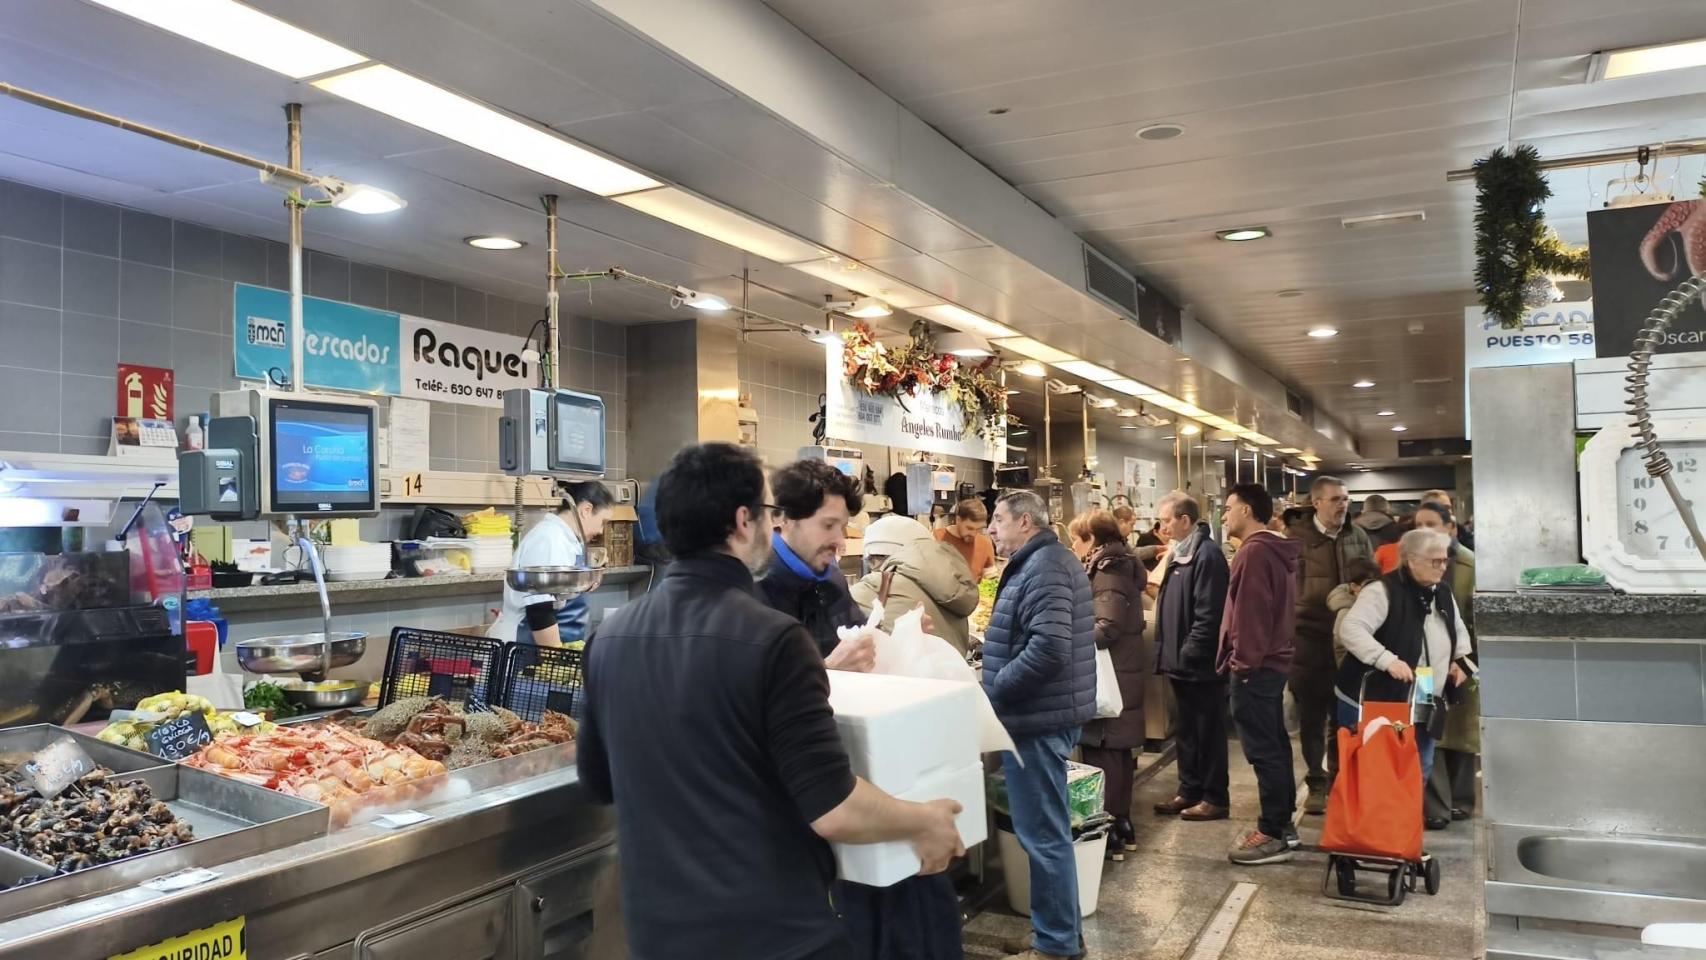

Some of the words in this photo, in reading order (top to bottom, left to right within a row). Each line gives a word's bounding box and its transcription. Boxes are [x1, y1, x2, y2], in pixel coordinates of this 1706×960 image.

[302, 330, 390, 365] escados
[1487, 334, 1561, 348] PUESTO
[1569, 333, 1594, 345] 58
[451, 383, 473, 396] 630
[476, 387, 494, 399] 647
[1677, 458, 1697, 473] 12
[405, 473, 422, 496] 14
[1633, 477, 1655, 490] 10
[1634, 498, 1647, 512] 9
[1634, 519, 1649, 534] 8
[1656, 535, 1669, 550] 7
